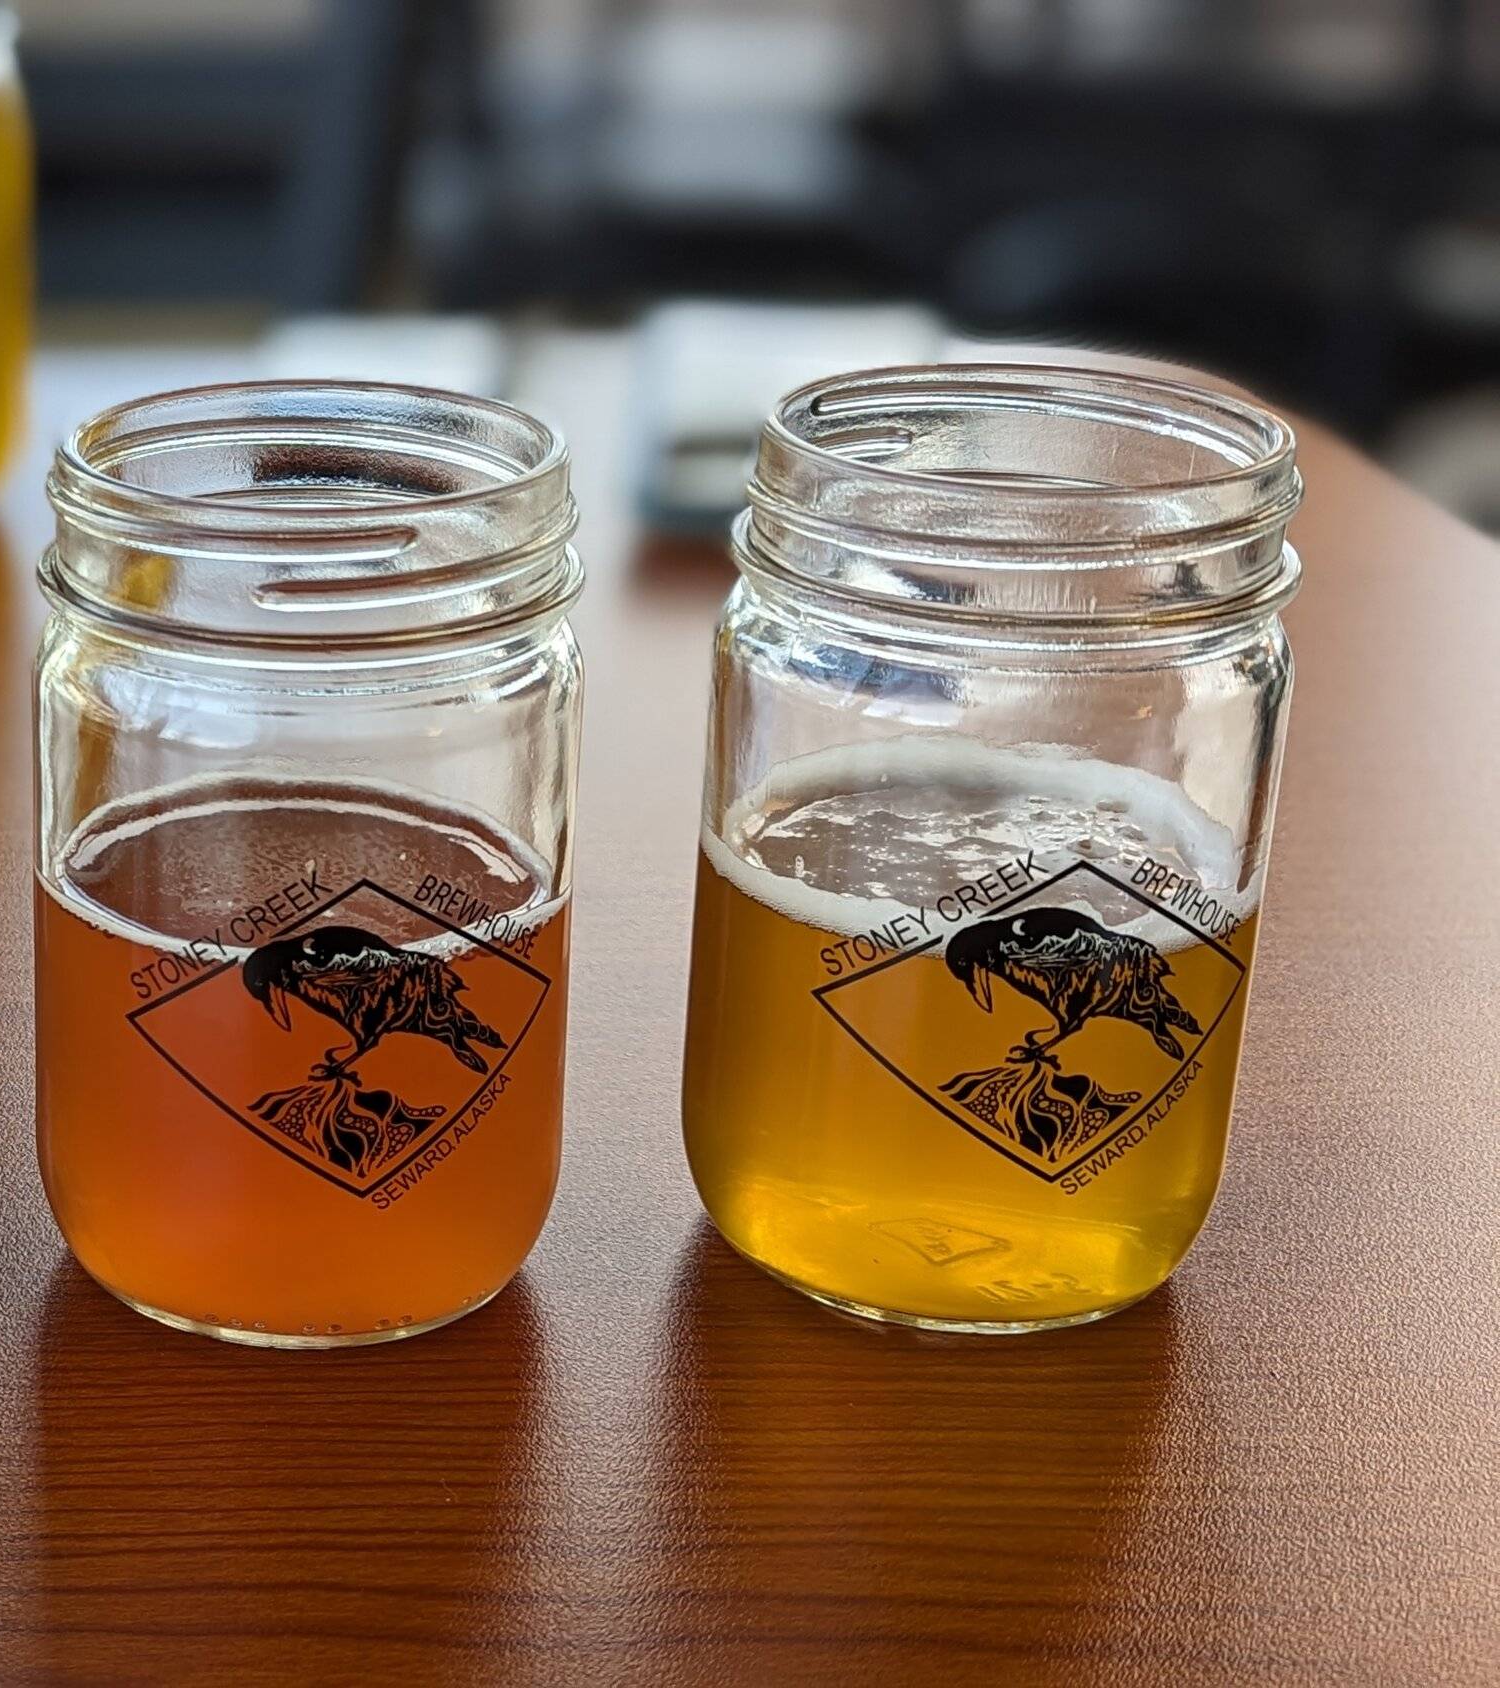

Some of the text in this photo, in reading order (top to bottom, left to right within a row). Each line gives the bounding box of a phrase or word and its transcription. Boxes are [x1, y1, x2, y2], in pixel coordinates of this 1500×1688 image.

[130, 870, 334, 1000] STONEY CREEK
[413, 874, 539, 960] BREWHOUSE
[820, 849, 1050, 976] STONEY CREEK
[1130, 857, 1242, 946] BREWHOUSE
[453, 1073, 513, 1145] ALASKA
[1146, 1060, 1204, 1131] ALASKA
